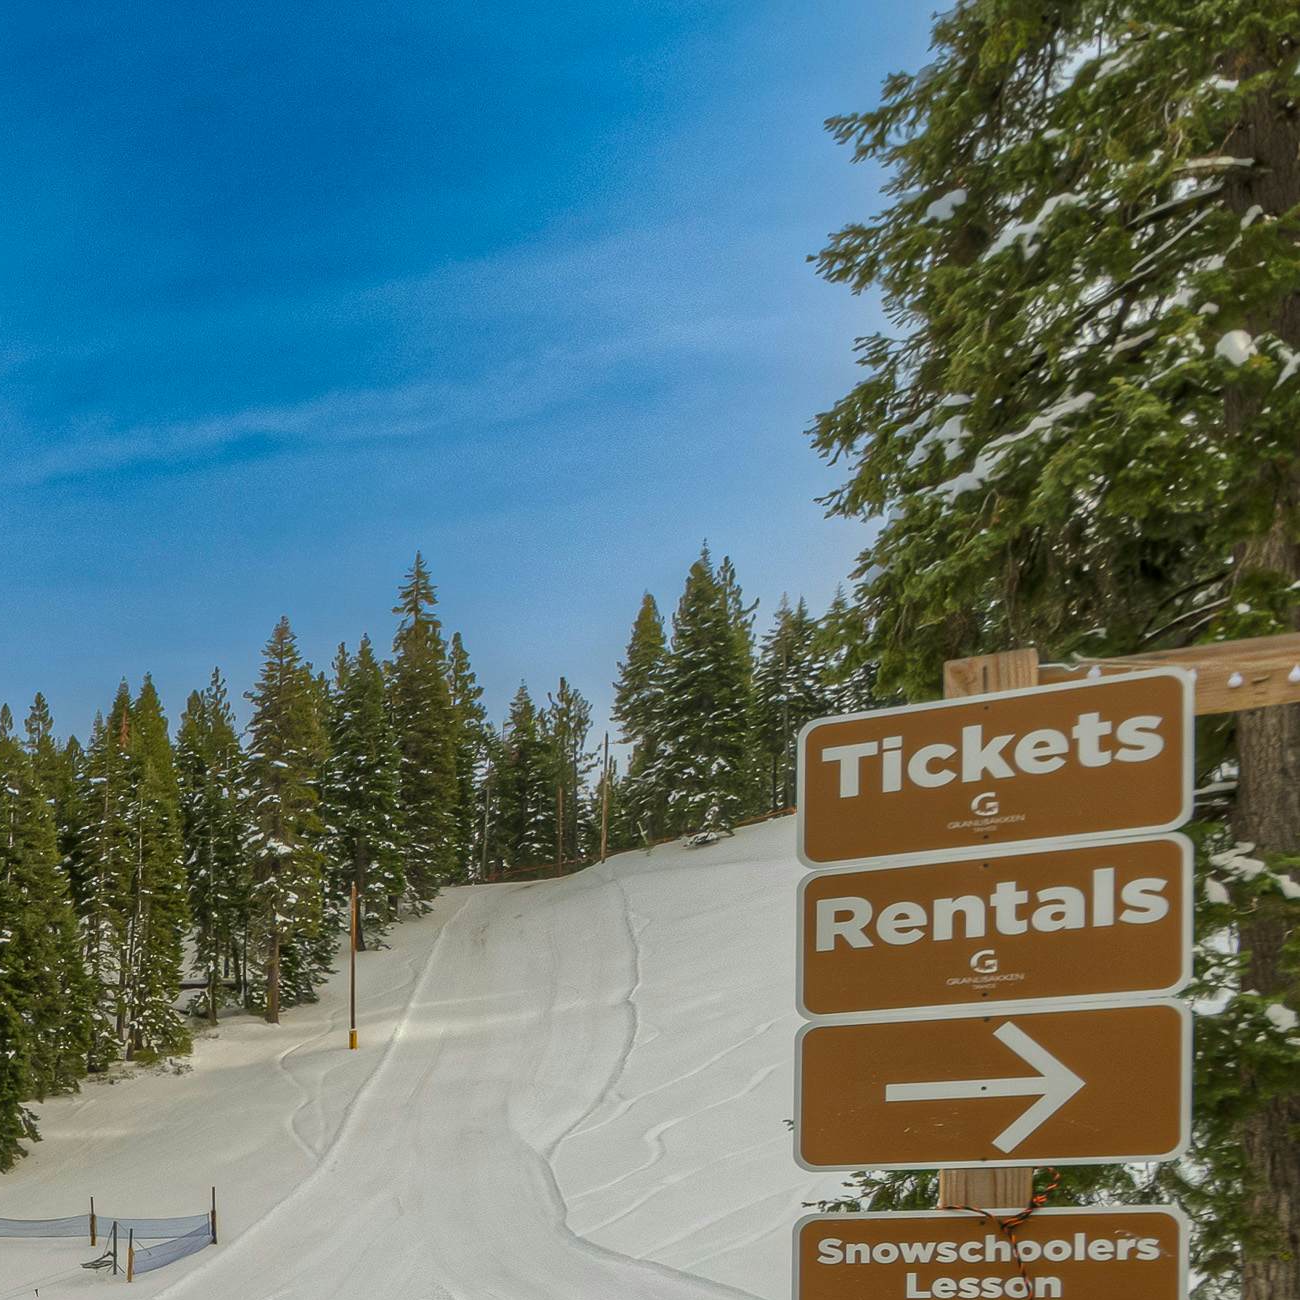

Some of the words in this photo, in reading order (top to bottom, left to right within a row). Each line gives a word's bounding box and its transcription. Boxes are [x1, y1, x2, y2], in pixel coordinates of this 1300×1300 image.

[822, 712, 1165, 799] Tickets
[815, 867, 1170, 952] Rentals
[816, 1233, 1161, 1265] Snowschoolers
[906, 1272, 1062, 1299] Lesson
